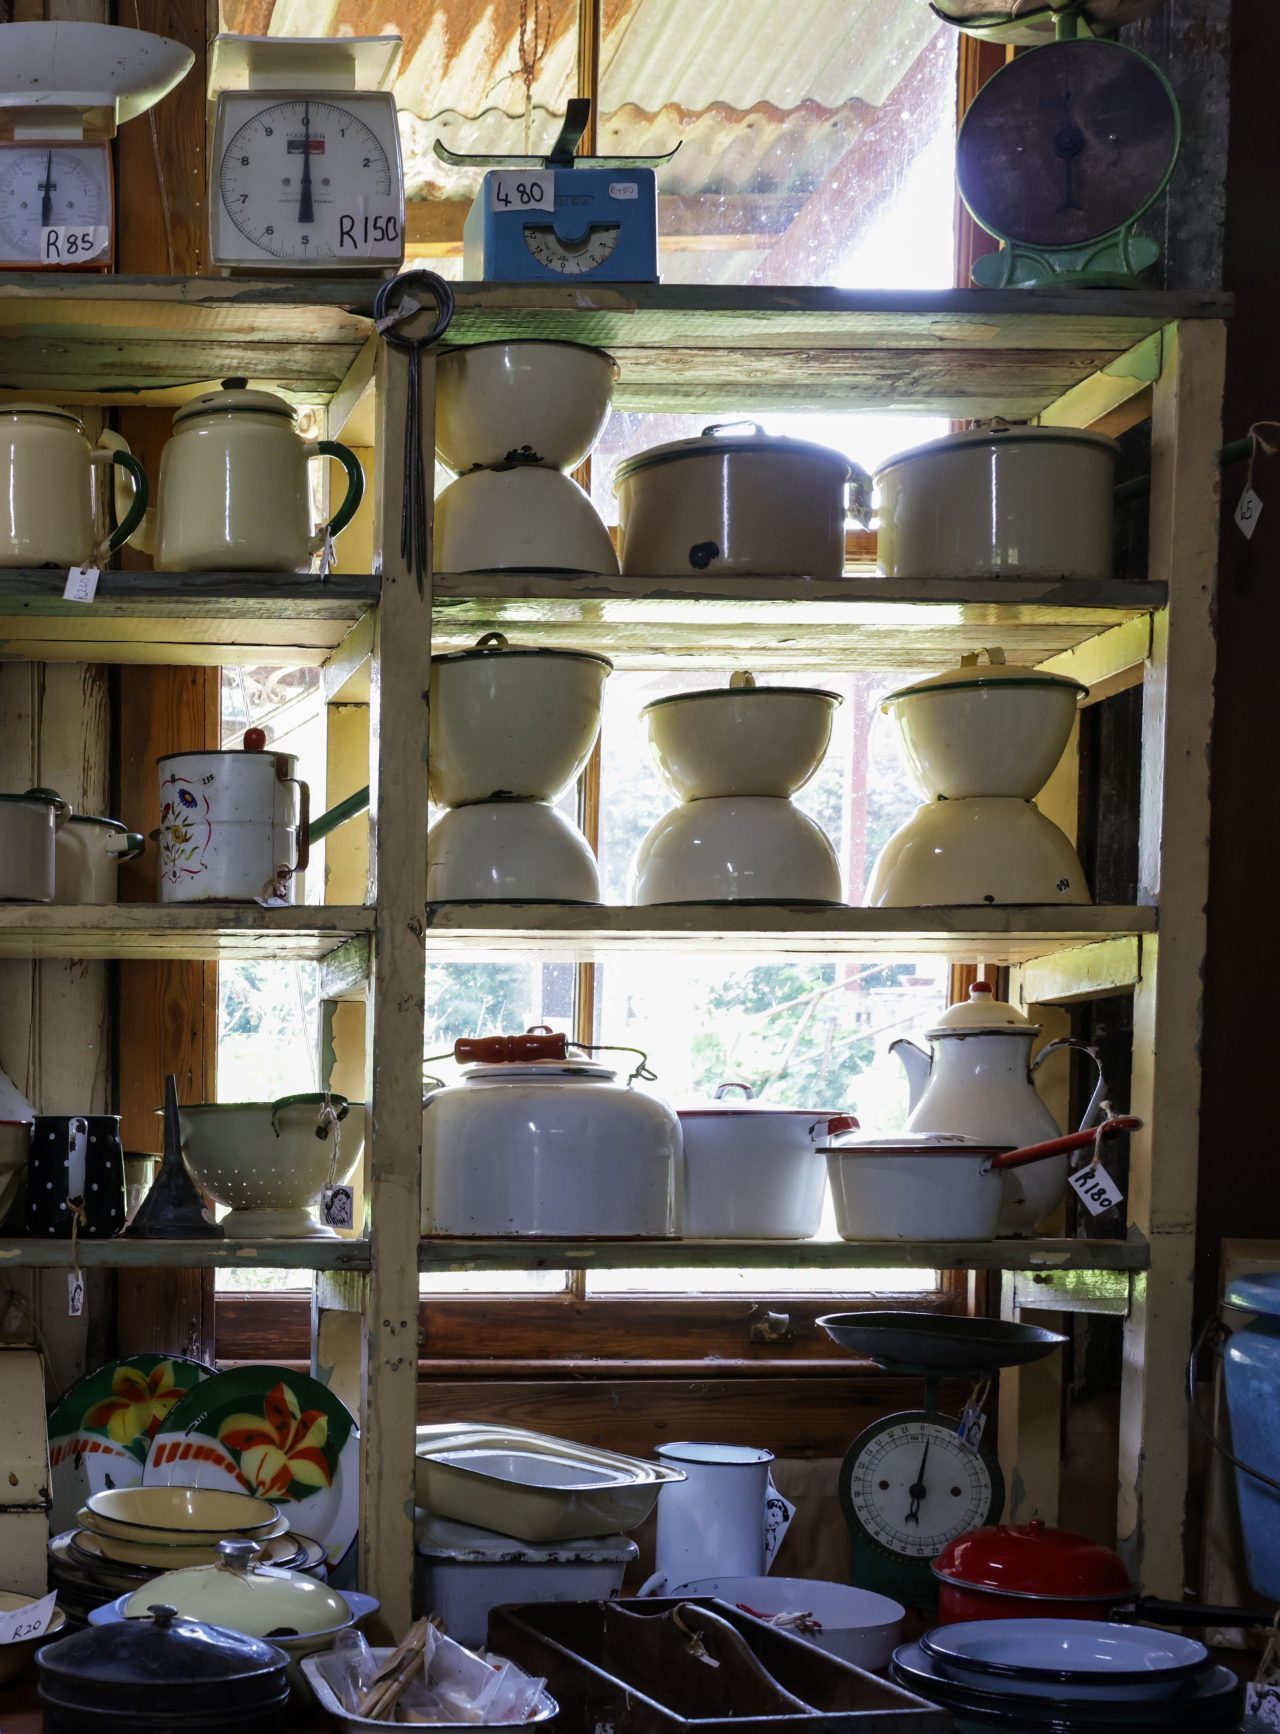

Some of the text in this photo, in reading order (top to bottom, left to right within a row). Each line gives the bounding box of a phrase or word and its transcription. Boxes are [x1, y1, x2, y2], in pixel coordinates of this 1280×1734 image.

[301, 117, 310, 126] 0
[265, 127, 273, 137] 9
[340, 128, 345, 138] 1
[240, 156, 249, 165] 8
[362, 158, 371, 168] 2
[239, 194, 249, 204] 7
[265, 225, 274, 235] 6
[339, 214, 399, 249] R150
[46, 229, 94, 259] R85
[301, 235, 310, 245] 5
[1074, 1171, 1112, 1207] R180
[12, 1620, 42, 1640] R20
